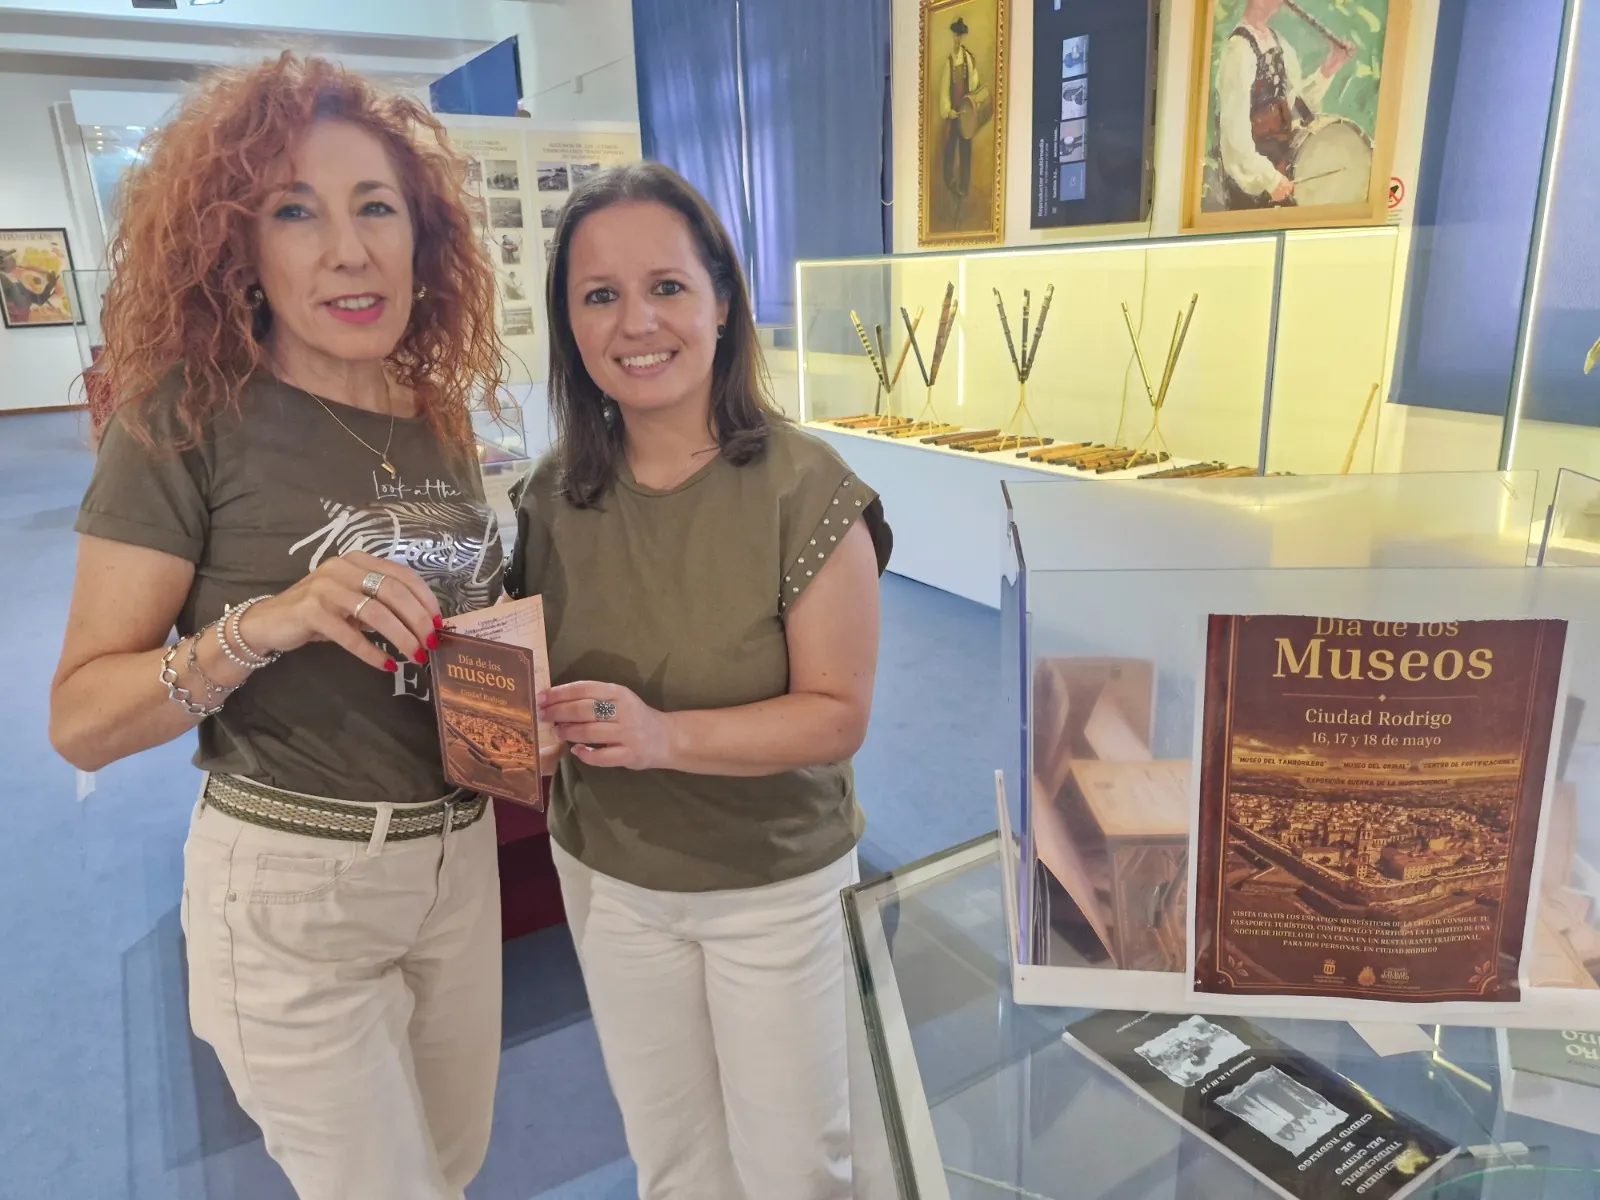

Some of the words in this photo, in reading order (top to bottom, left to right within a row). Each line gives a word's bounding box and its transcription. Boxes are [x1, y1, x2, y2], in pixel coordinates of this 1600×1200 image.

[458, 654, 474, 667] Día
[476, 657, 487, 669] de
[488, 660, 502, 673] los
[1272, 637, 1494, 682] Museos
[447, 663, 516, 692] museos
[1304, 708, 1373, 726] Ciudad
[1378, 711, 1453, 730] Rodrigo
[1311, 731, 1331, 747] 16,
[1334, 733, 1348, 744] 17
[1351, 735, 1360, 748] y
[1363, 734, 1378, 746] 18
[1381, 735, 1398, 746] de
[1402, 737, 1442, 748] mayo
[1230, 919, 1273, 928] PASAPORTE
[1232, 910, 1257, 918] VISITA
[1257, 911, 1285, 919] GRATIS
[1234, 928, 1260, 936] NOCHE
[1272, 930, 1297, 938] HOTEL
[1333, 935, 1356, 943] CENA
[1380, 937, 1433, 946] RESTAURANTE
[1363, 945, 1374, 953] EN
[1375, 945, 1405, 954] CIUDAD
[1405, 946, 1438, 955] RODRIGO
[1339, 1113, 1373, 1139] CIUDAD
[1340, 1141, 1356, 1153] DE
[1366, 1136, 1386, 1150] DEL
[1297, 1136, 1341, 1172] RODRIGO
[1335, 1148, 1368, 1175] CAMPO
[1341, 1141, 1403, 1187] TRADICIONAL
